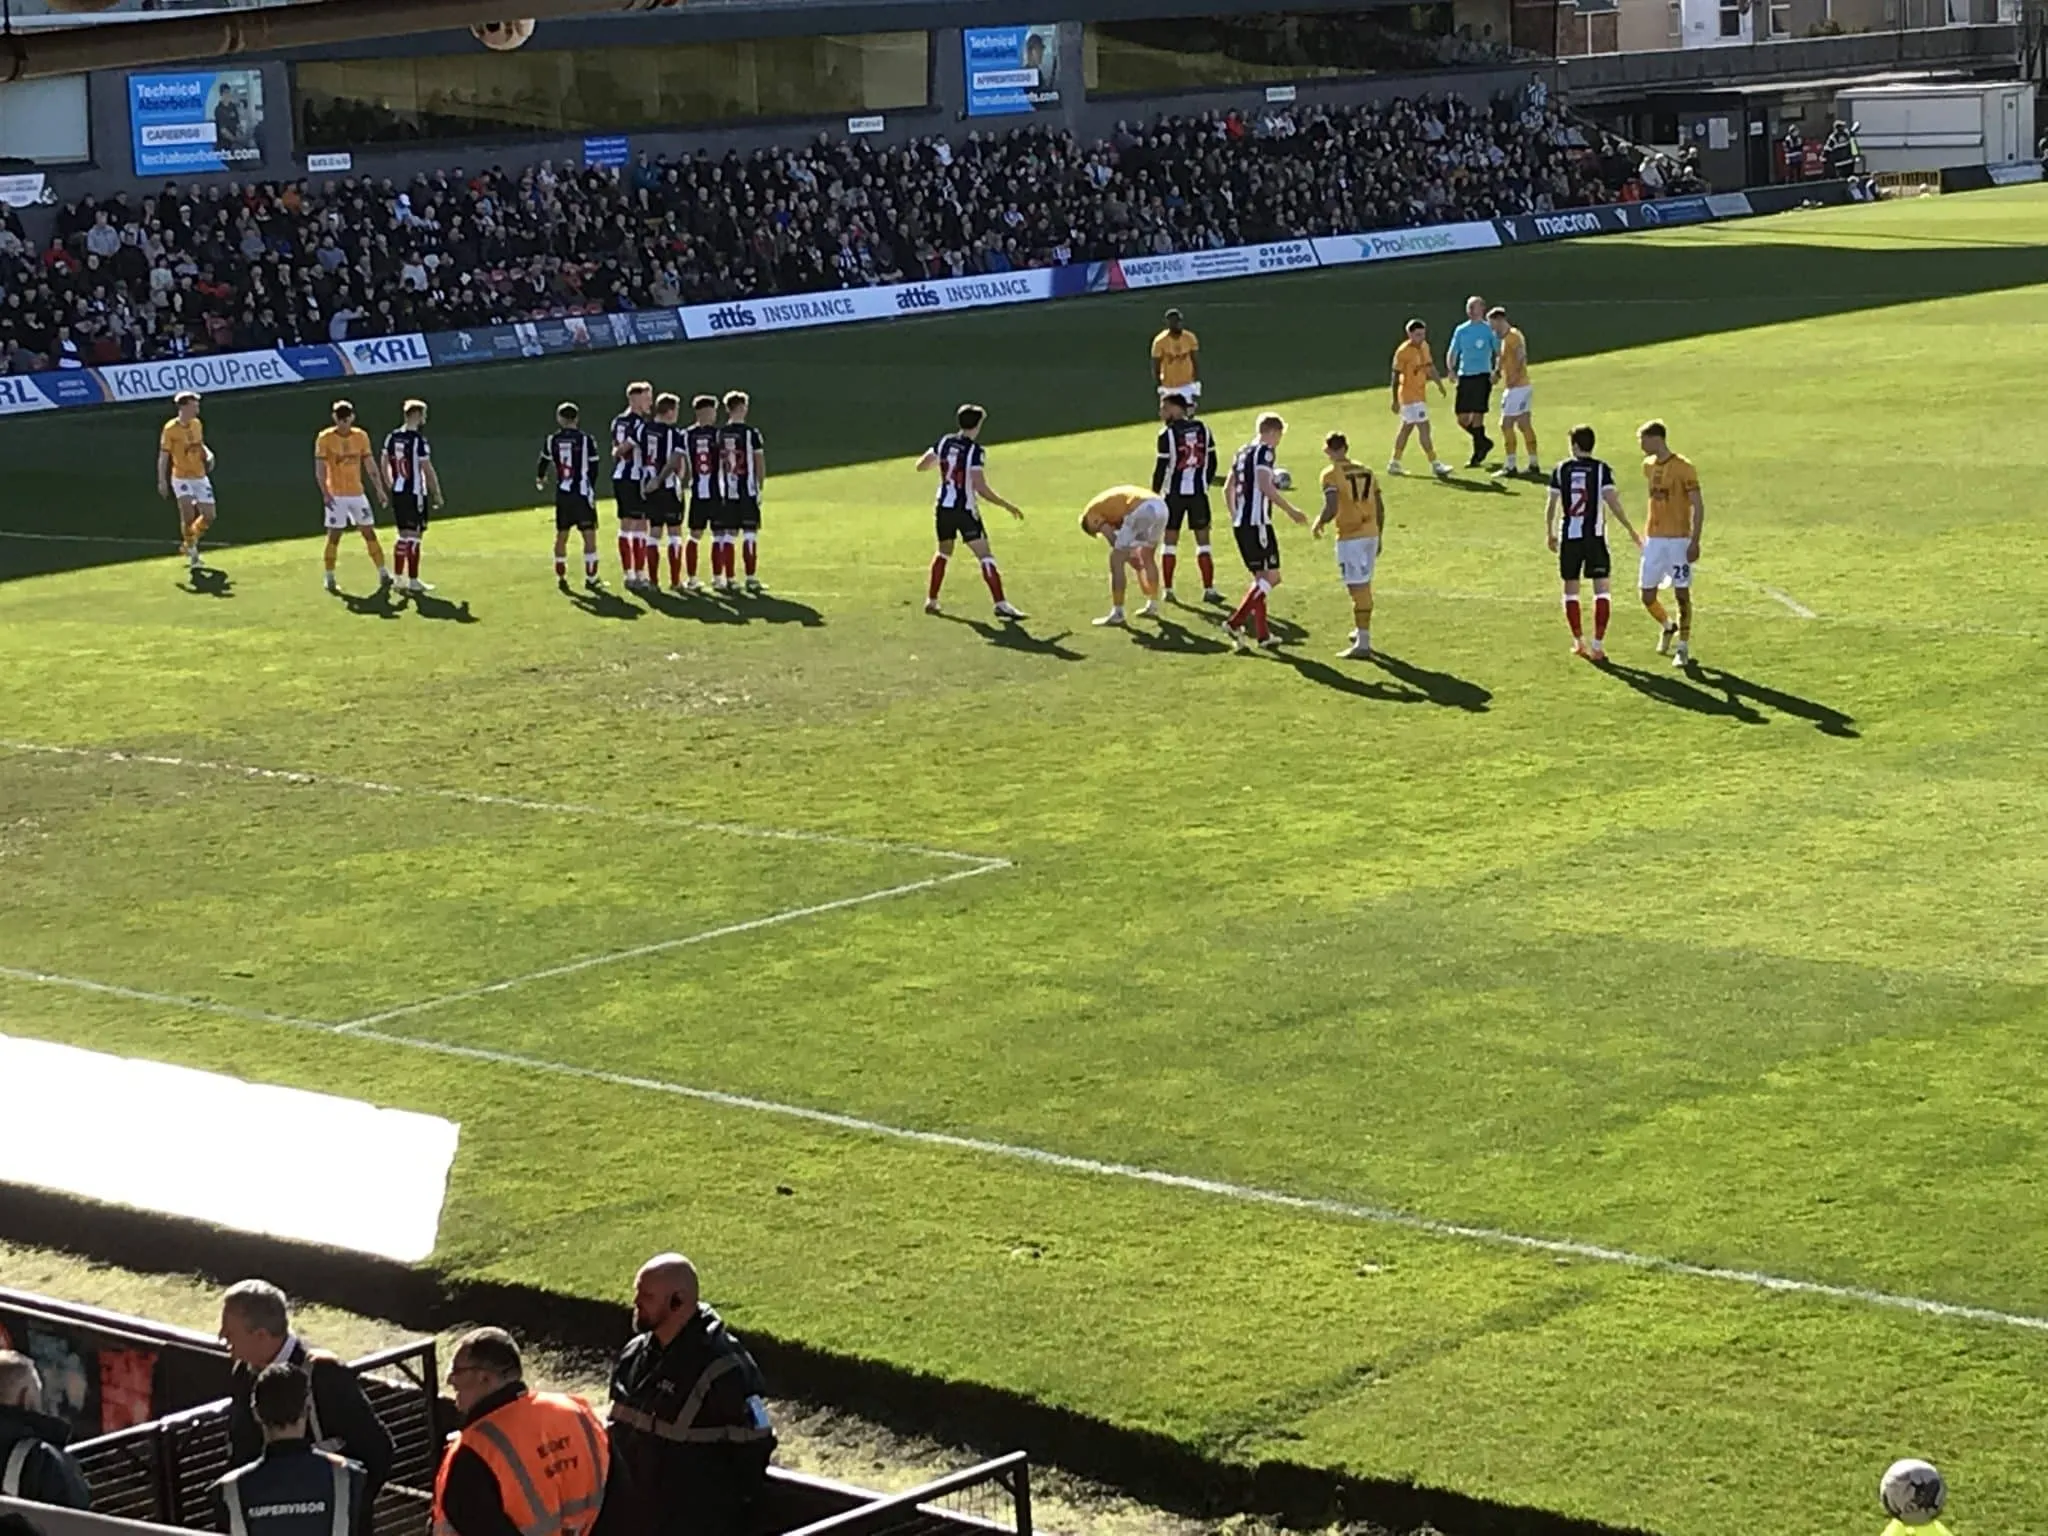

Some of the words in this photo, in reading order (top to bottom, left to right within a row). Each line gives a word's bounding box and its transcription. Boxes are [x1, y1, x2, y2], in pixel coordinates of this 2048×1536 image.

[136, 81, 201, 98] Technical
[1535, 211, 1601, 236] macron
[1259, 244, 1302, 257] 01469
[1371, 232, 1456, 255] ProAmpac
[895, 284, 941, 310] attis
[945, 279, 1031, 303] INSURANCE
[708, 303, 757, 331] attis
[762, 297, 855, 324] INSURANCE
[364, 337, 428, 365] KRL
[114, 357, 284, 397] KRLGROUP.net
[1345, 472, 1373, 502] 17
[1568, 487, 1589, 517] 2
[1673, 563, 1691, 580] 28
[247, 1501, 326, 1519] SUPERVISOR
